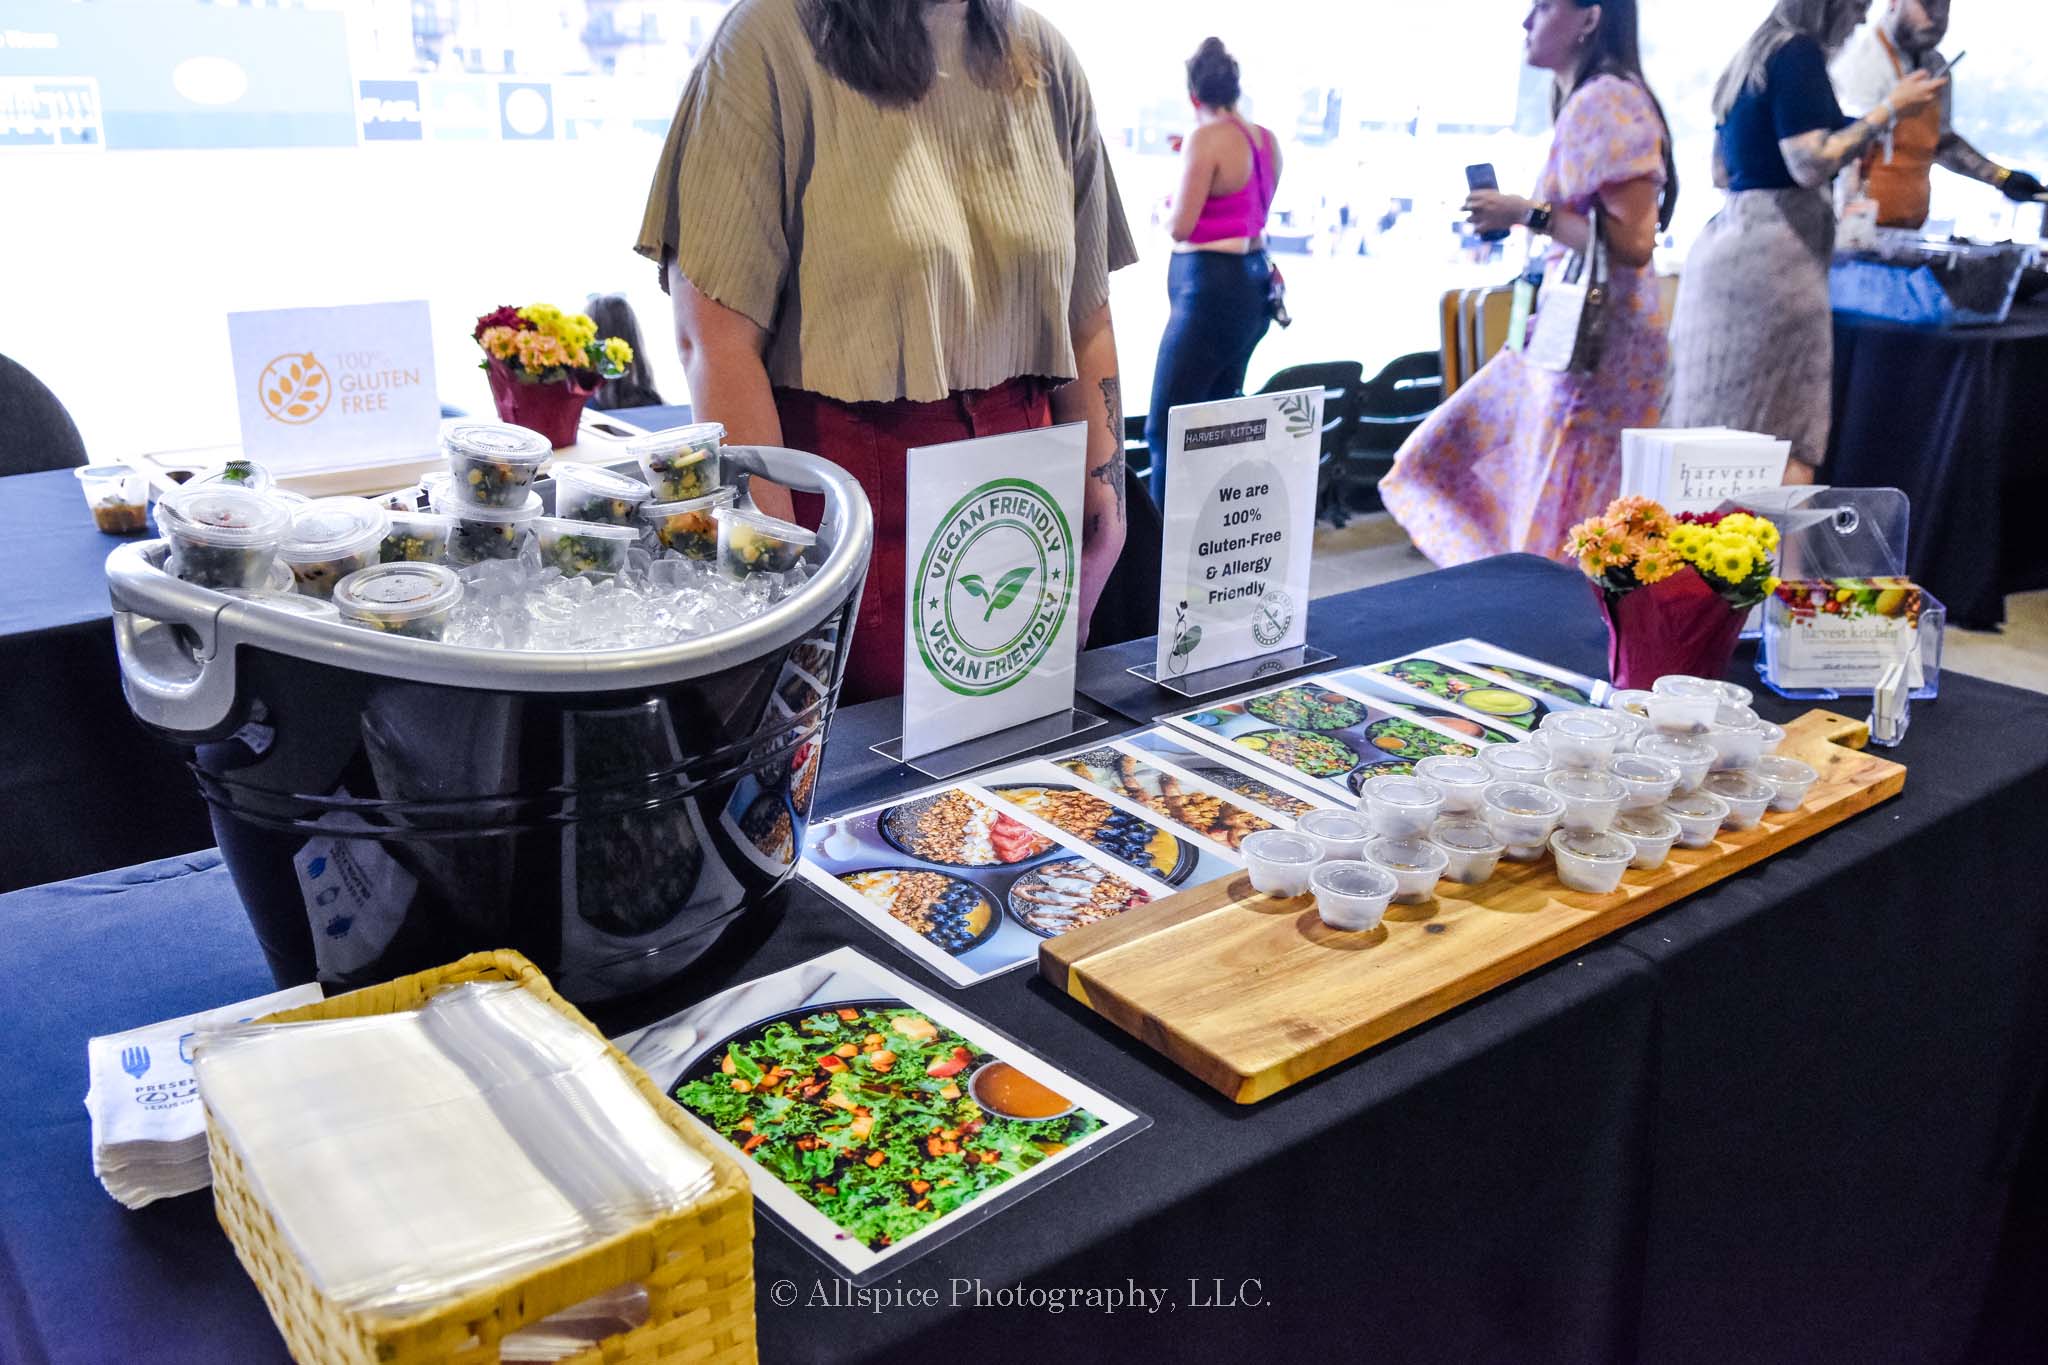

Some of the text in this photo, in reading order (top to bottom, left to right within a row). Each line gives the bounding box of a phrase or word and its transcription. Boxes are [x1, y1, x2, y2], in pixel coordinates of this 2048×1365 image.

[338, 368, 421, 393] GLUTEN
[340, 392, 390, 414] FREE
[1185, 430, 1225, 444] HARVEST
[1230, 423, 1266, 438] KITCHEN
[1680, 464, 1766, 480] harvest
[1219, 484, 1269, 502] We are
[1223, 508, 1262, 527] 100%
[930, 496, 1061, 580] VEGAN FRIENDLY
[1198, 531, 1282, 557] Gluten-Free
[1206, 557, 1272, 580] & Allergy
[1208, 581, 1266, 604] Friendly
[929, 592, 1058, 680] VEGAN FRIENDLY
